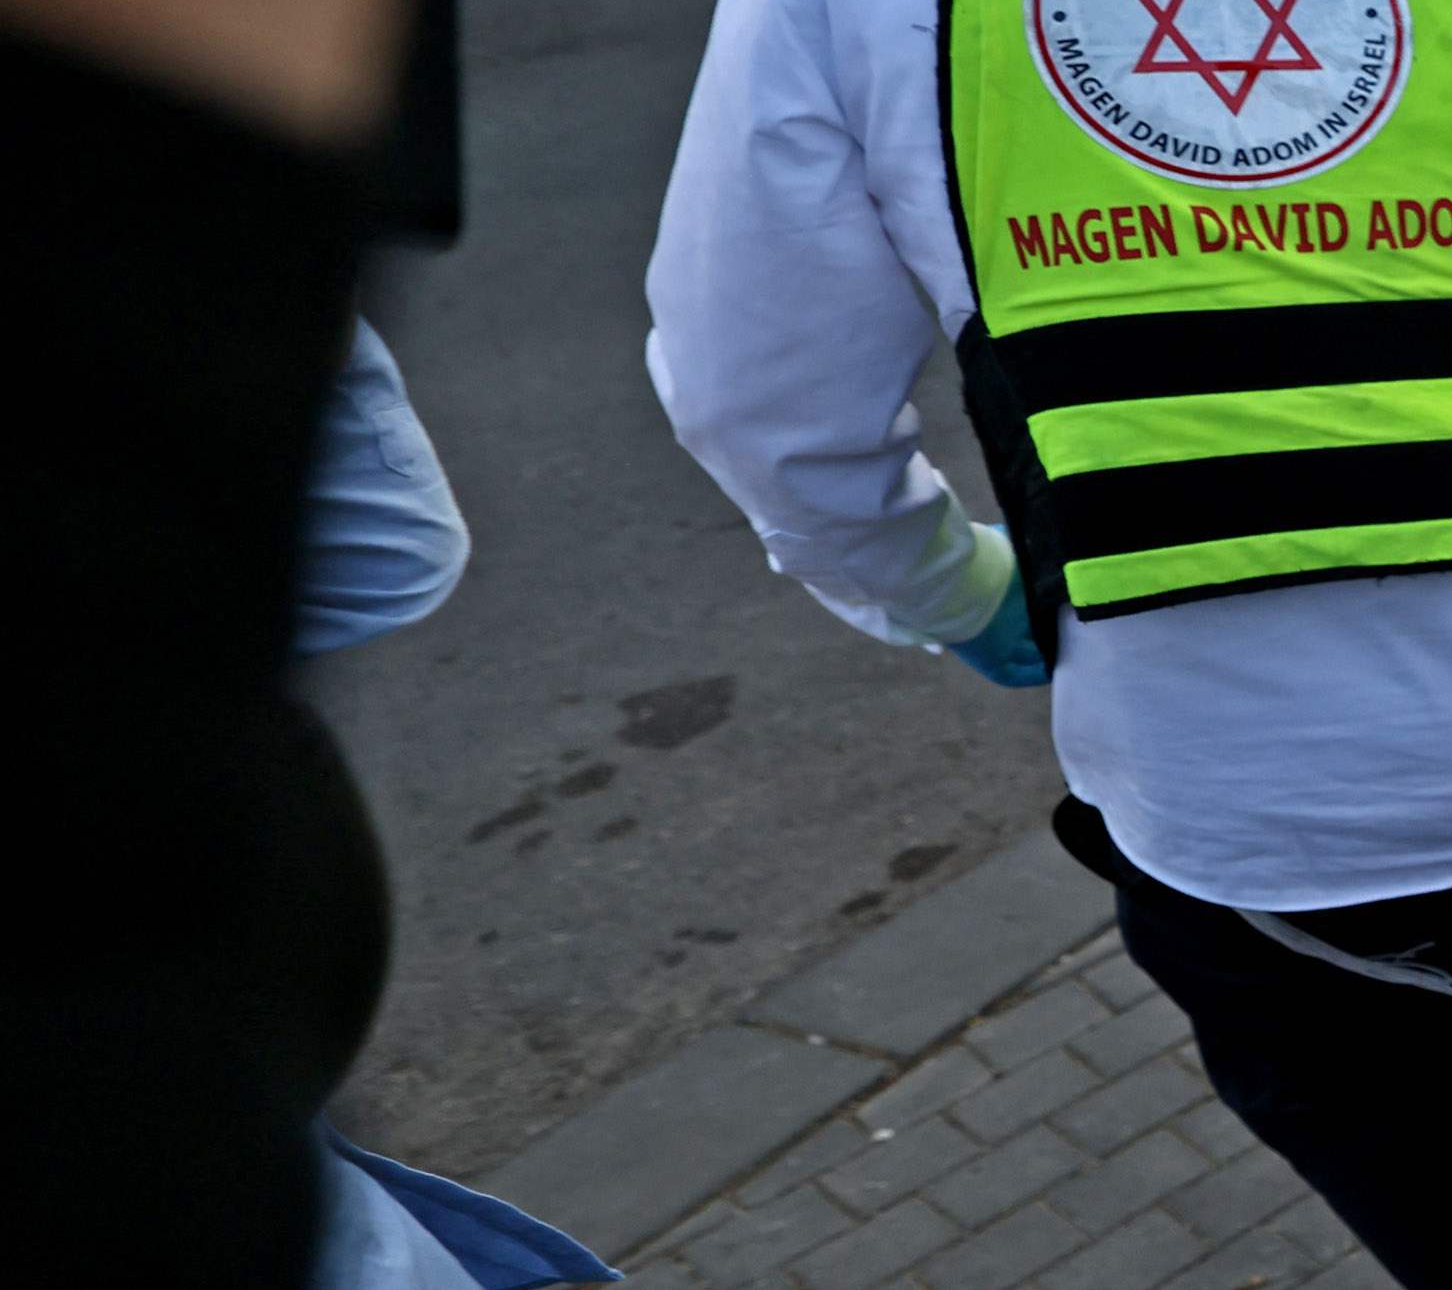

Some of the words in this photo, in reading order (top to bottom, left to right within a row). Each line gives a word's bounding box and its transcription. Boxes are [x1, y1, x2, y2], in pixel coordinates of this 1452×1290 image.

[1056, 35, 1131, 126] MAGEN
[1129, 119, 1223, 167] DAVID
[1232, 130, 1320, 169] ADOM
[1316, 109, 1350, 140] IN
[1342, 31, 1388, 118] ISRAEL
[1007, 204, 1179, 270] MAGEN
[1191, 201, 1349, 254] DAVID
